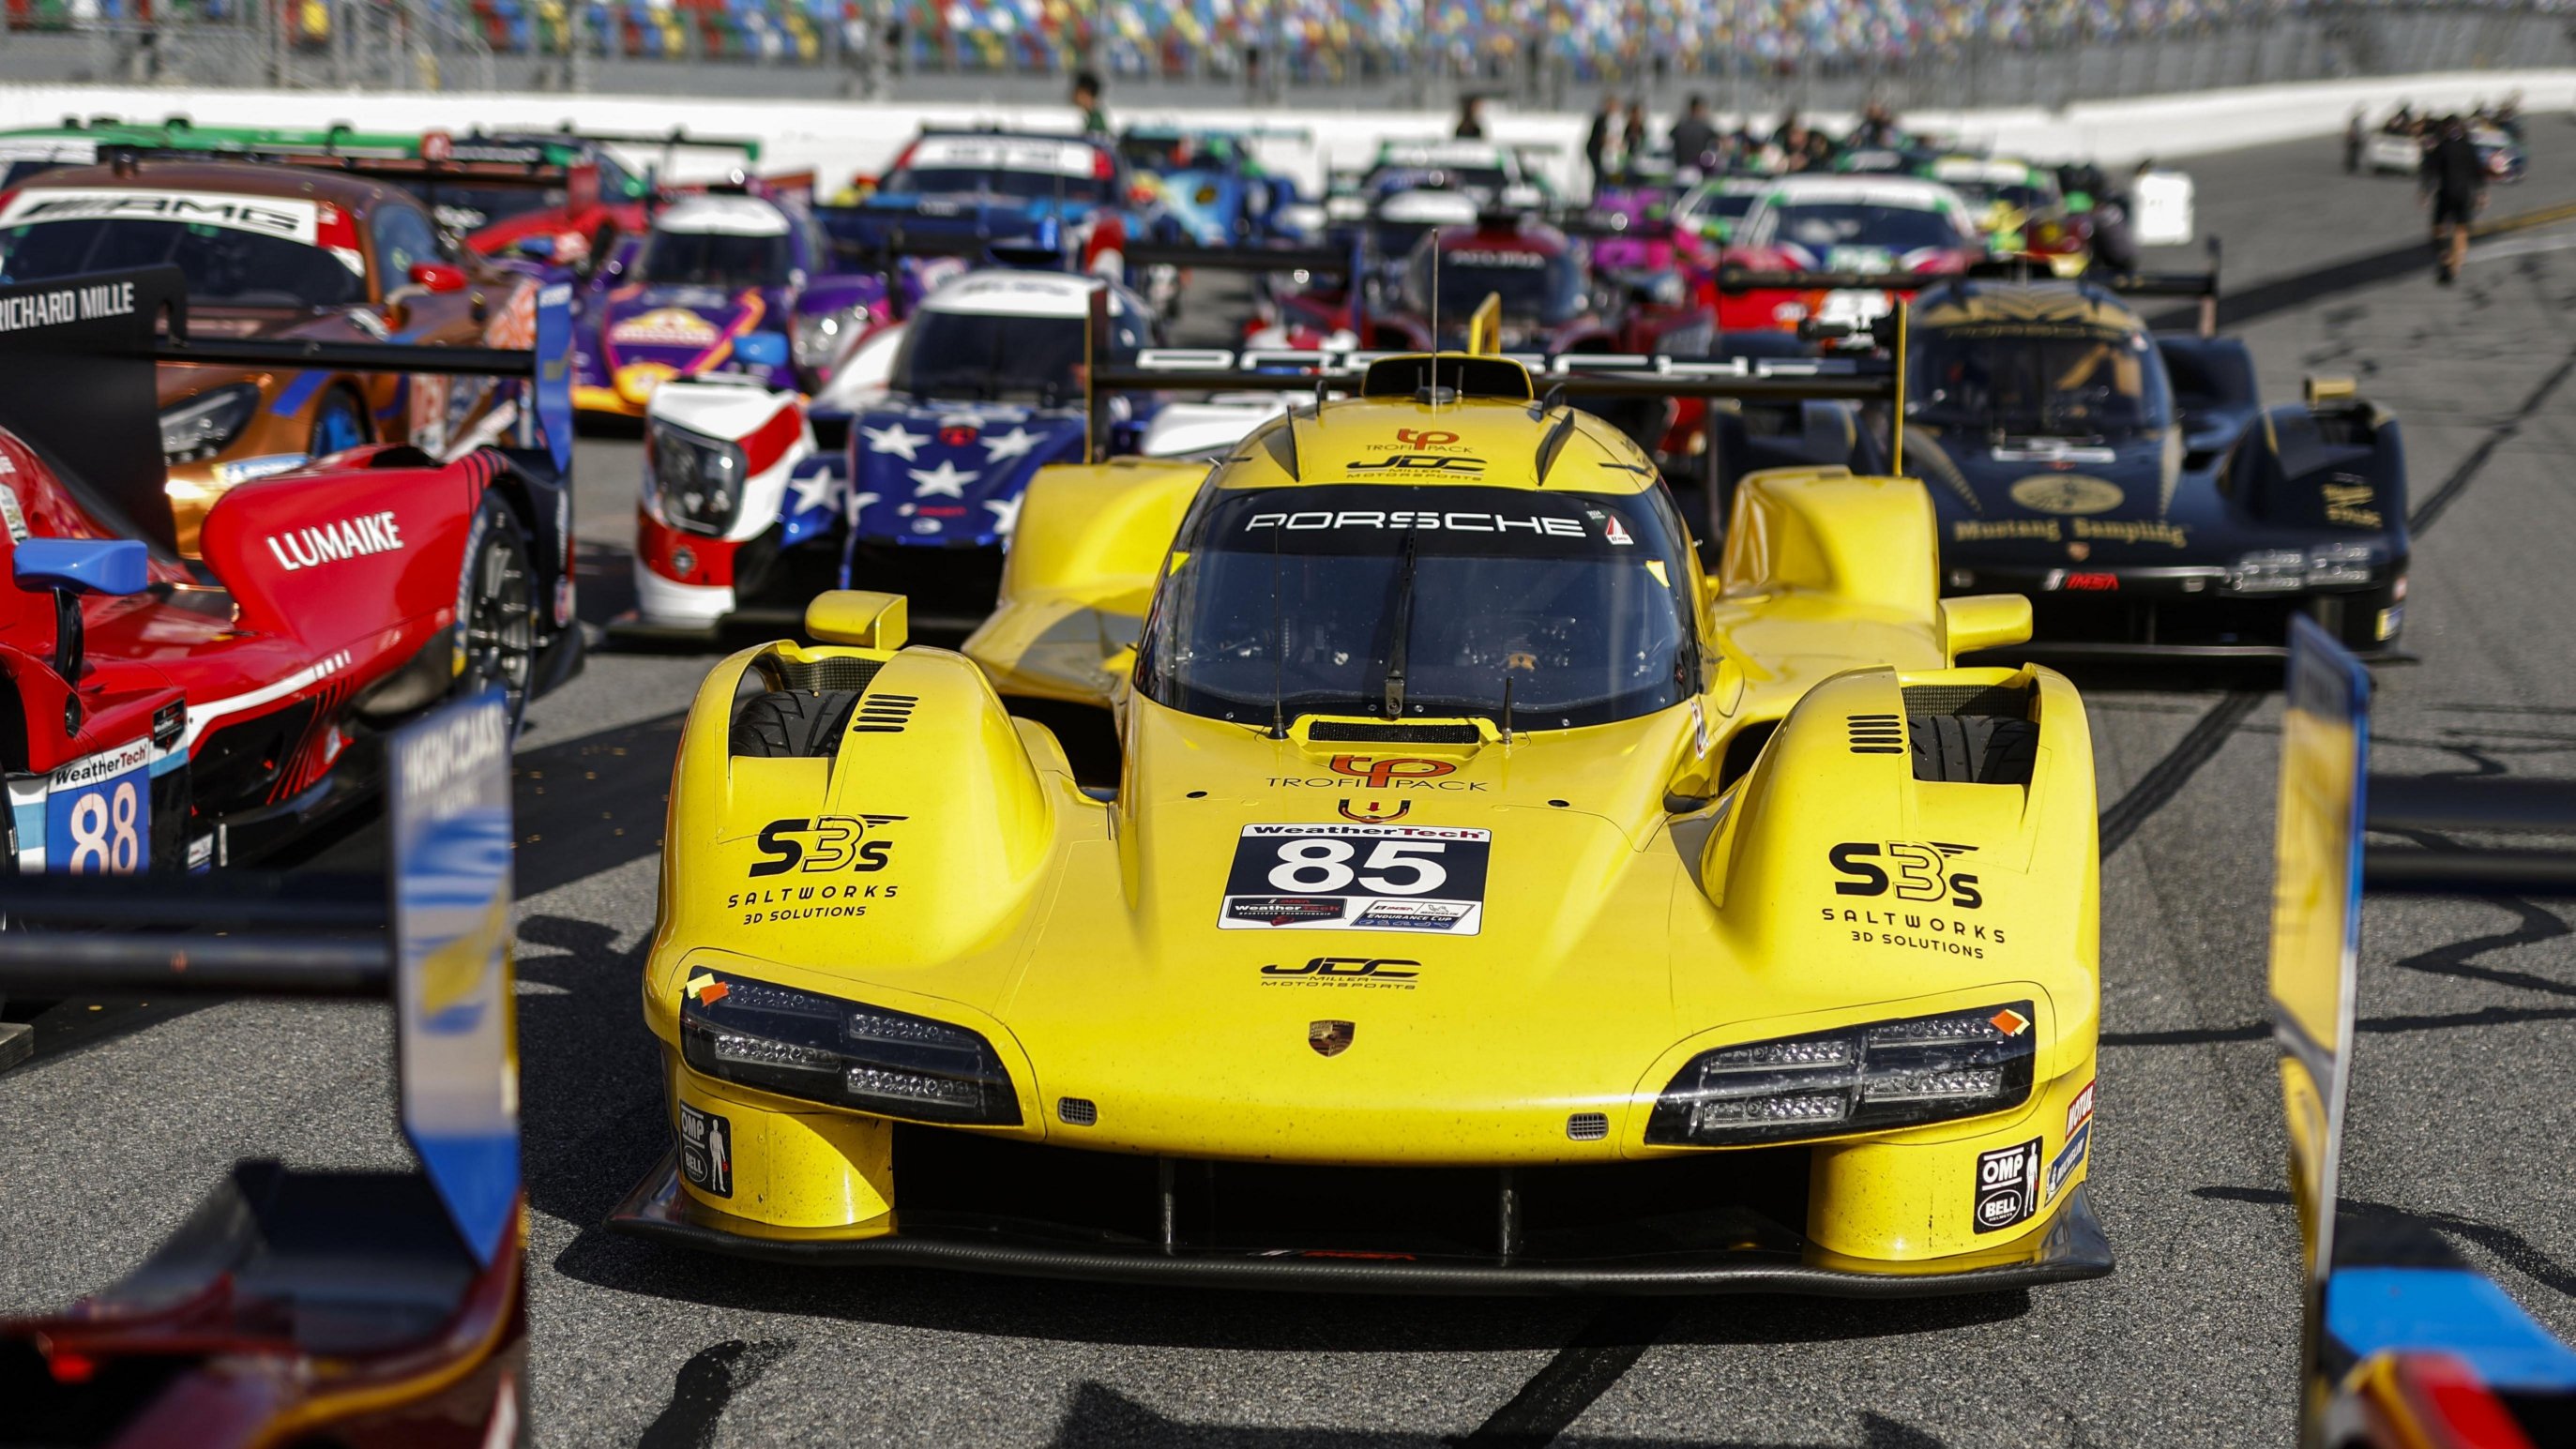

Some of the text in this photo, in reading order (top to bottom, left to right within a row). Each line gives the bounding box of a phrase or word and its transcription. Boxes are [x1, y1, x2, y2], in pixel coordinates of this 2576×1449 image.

[105, 194, 299, 233] AMG
[80, 282, 135, 317] MILLE
[1428, 445, 1474, 454] PACK
[1346, 455, 1488, 472] JDC
[1346, 474, 1482, 482] MOTORSPORTS
[1245, 511, 1587, 537] PORSCHE
[266, 511, 405, 571] LUMAIKE
[2067, 573, 2119, 591] IMSA
[55, 744, 148, 786] WeatherTech
[1265, 777, 1489, 792] TROFI PACK
[70, 781, 138, 875] 88
[1253, 826, 1482, 839] WeatherTech
[1267, 838, 1447, 896] 85
[728, 885, 899, 909] SALTWORKS
[743, 906, 867, 926] 3D SOLUTIONS
[1822, 908, 2006, 943] SALTWORKS
[1852, 931, 1984, 959] 3D SOLUTIONS
[1260, 957, 1422, 978] JDC
[1261, 981, 1416, 990] MOTORSPORTS
[2066, 1084, 2094, 1137] MOTUL
[681, 1111, 705, 1141] OMP
[685, 1152, 704, 1175] BELL
[1982, 1154, 2024, 1185] OMP
[1985, 1197, 2017, 1218] BELL
